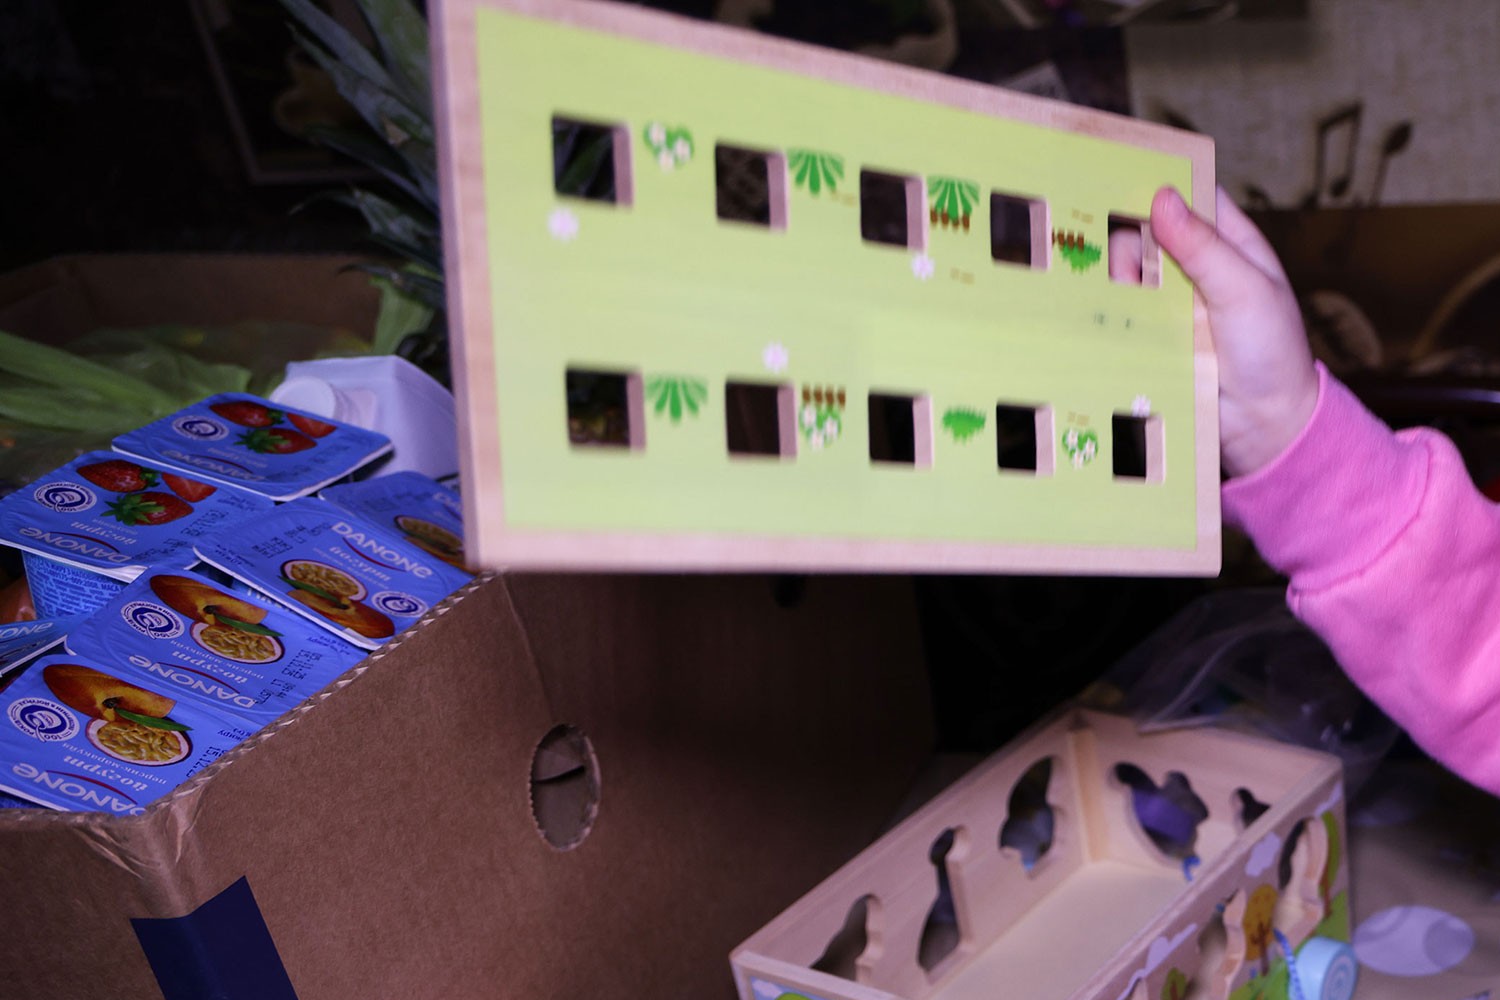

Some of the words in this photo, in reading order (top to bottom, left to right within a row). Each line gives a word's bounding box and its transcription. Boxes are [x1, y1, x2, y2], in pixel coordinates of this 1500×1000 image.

[18, 527, 132, 563] DANONE
[331, 521, 433, 578] DANONE
[128, 654, 256, 708] DANONE
